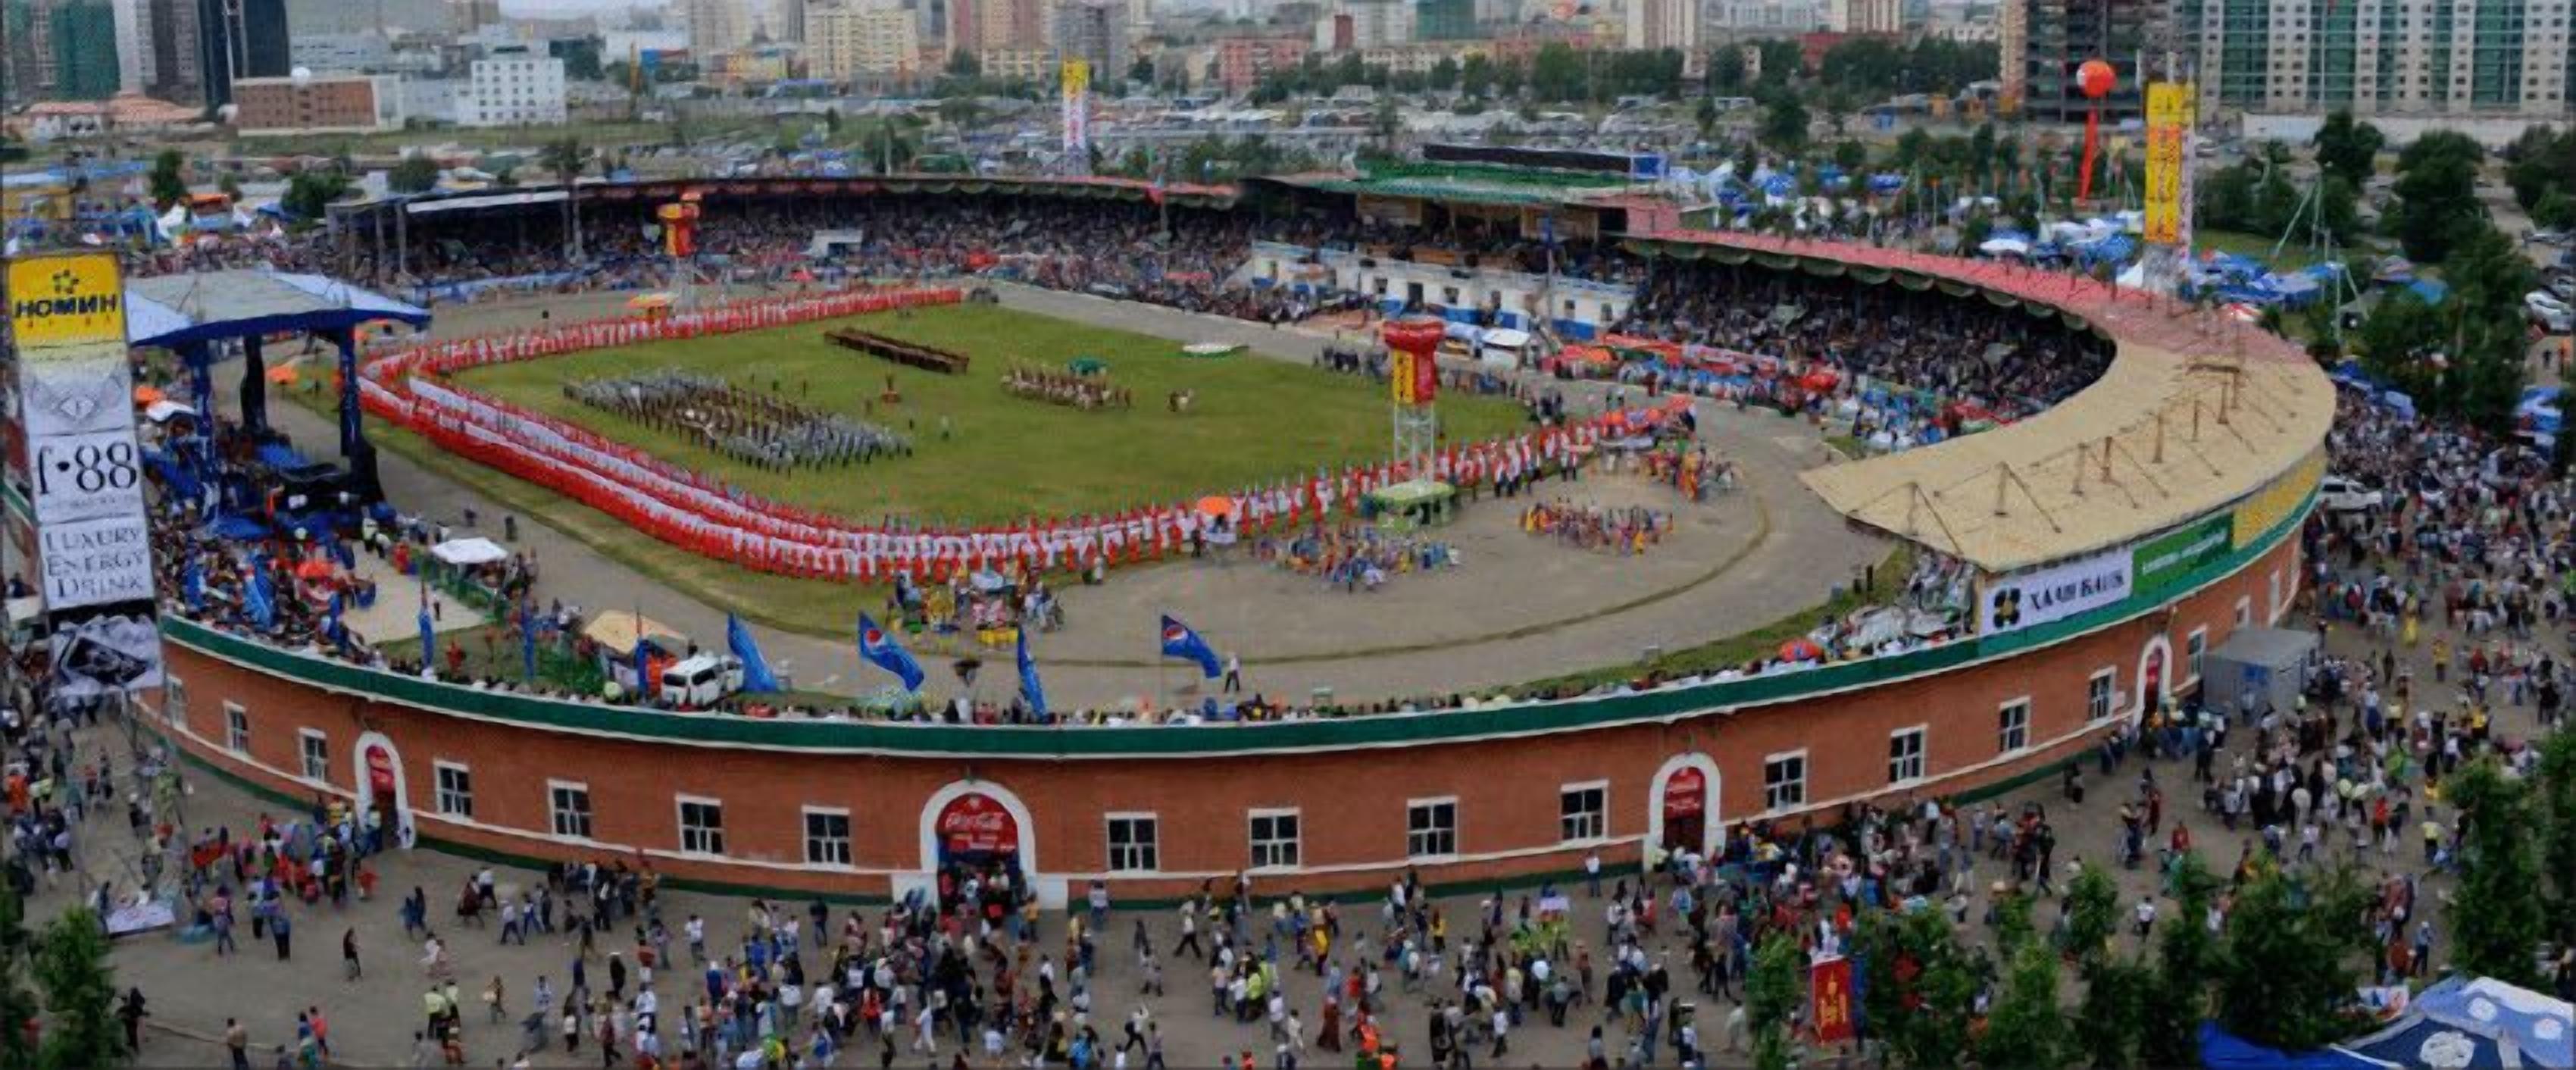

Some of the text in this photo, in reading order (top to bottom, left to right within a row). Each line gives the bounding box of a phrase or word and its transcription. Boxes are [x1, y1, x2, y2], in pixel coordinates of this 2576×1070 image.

[15, 293, 116, 318] НОМИН
[48, 549, 144, 577] ENERGY
[57, 576, 143, 598] DRINK
